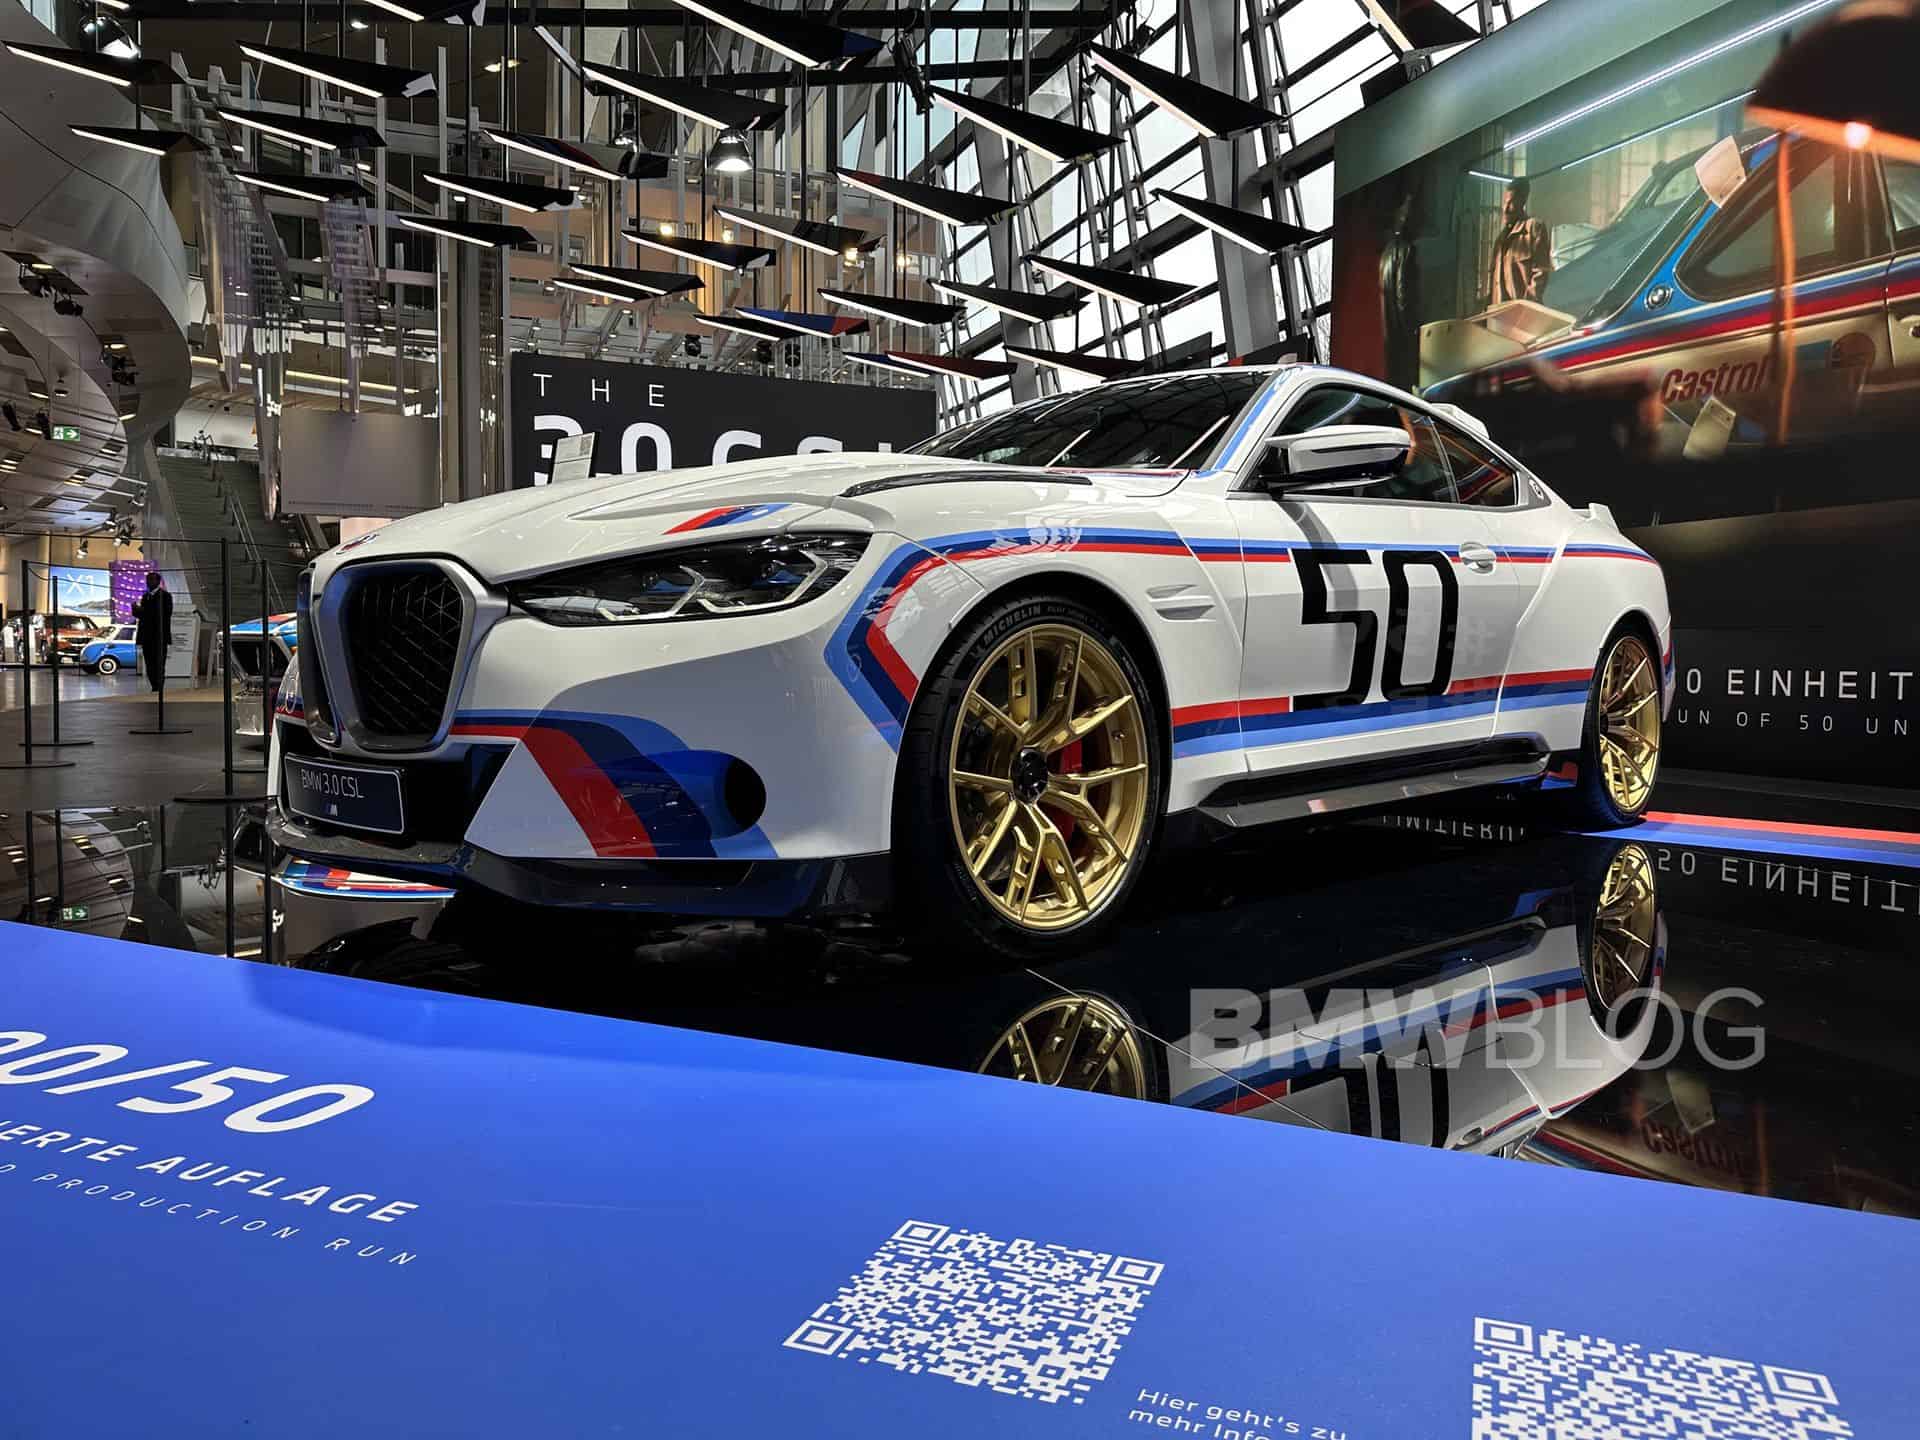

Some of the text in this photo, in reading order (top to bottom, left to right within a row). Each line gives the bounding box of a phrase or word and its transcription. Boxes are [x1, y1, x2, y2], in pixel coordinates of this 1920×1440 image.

[533, 373, 665, 407] THE
[1661, 354, 1772, 404] Castrol
[983, 604, 1041, 647] MICHELIN
[1290, 549, 1459, 712] 50
[1736, 711, 1771, 728] OF
[1799, 714, 1833, 732] 50
[301, 768, 365, 799] BMW 3.0 CSL
[0, 1120, 420, 1223] ERTE AUFLAGE
[32, 1172, 300, 1239] PRODUCTION
[324, 1237, 417, 1265] RUN
[1128, 1408, 1207, 1434] mehr
[1137, 1388, 1347, 1440] Hier geht's zu
